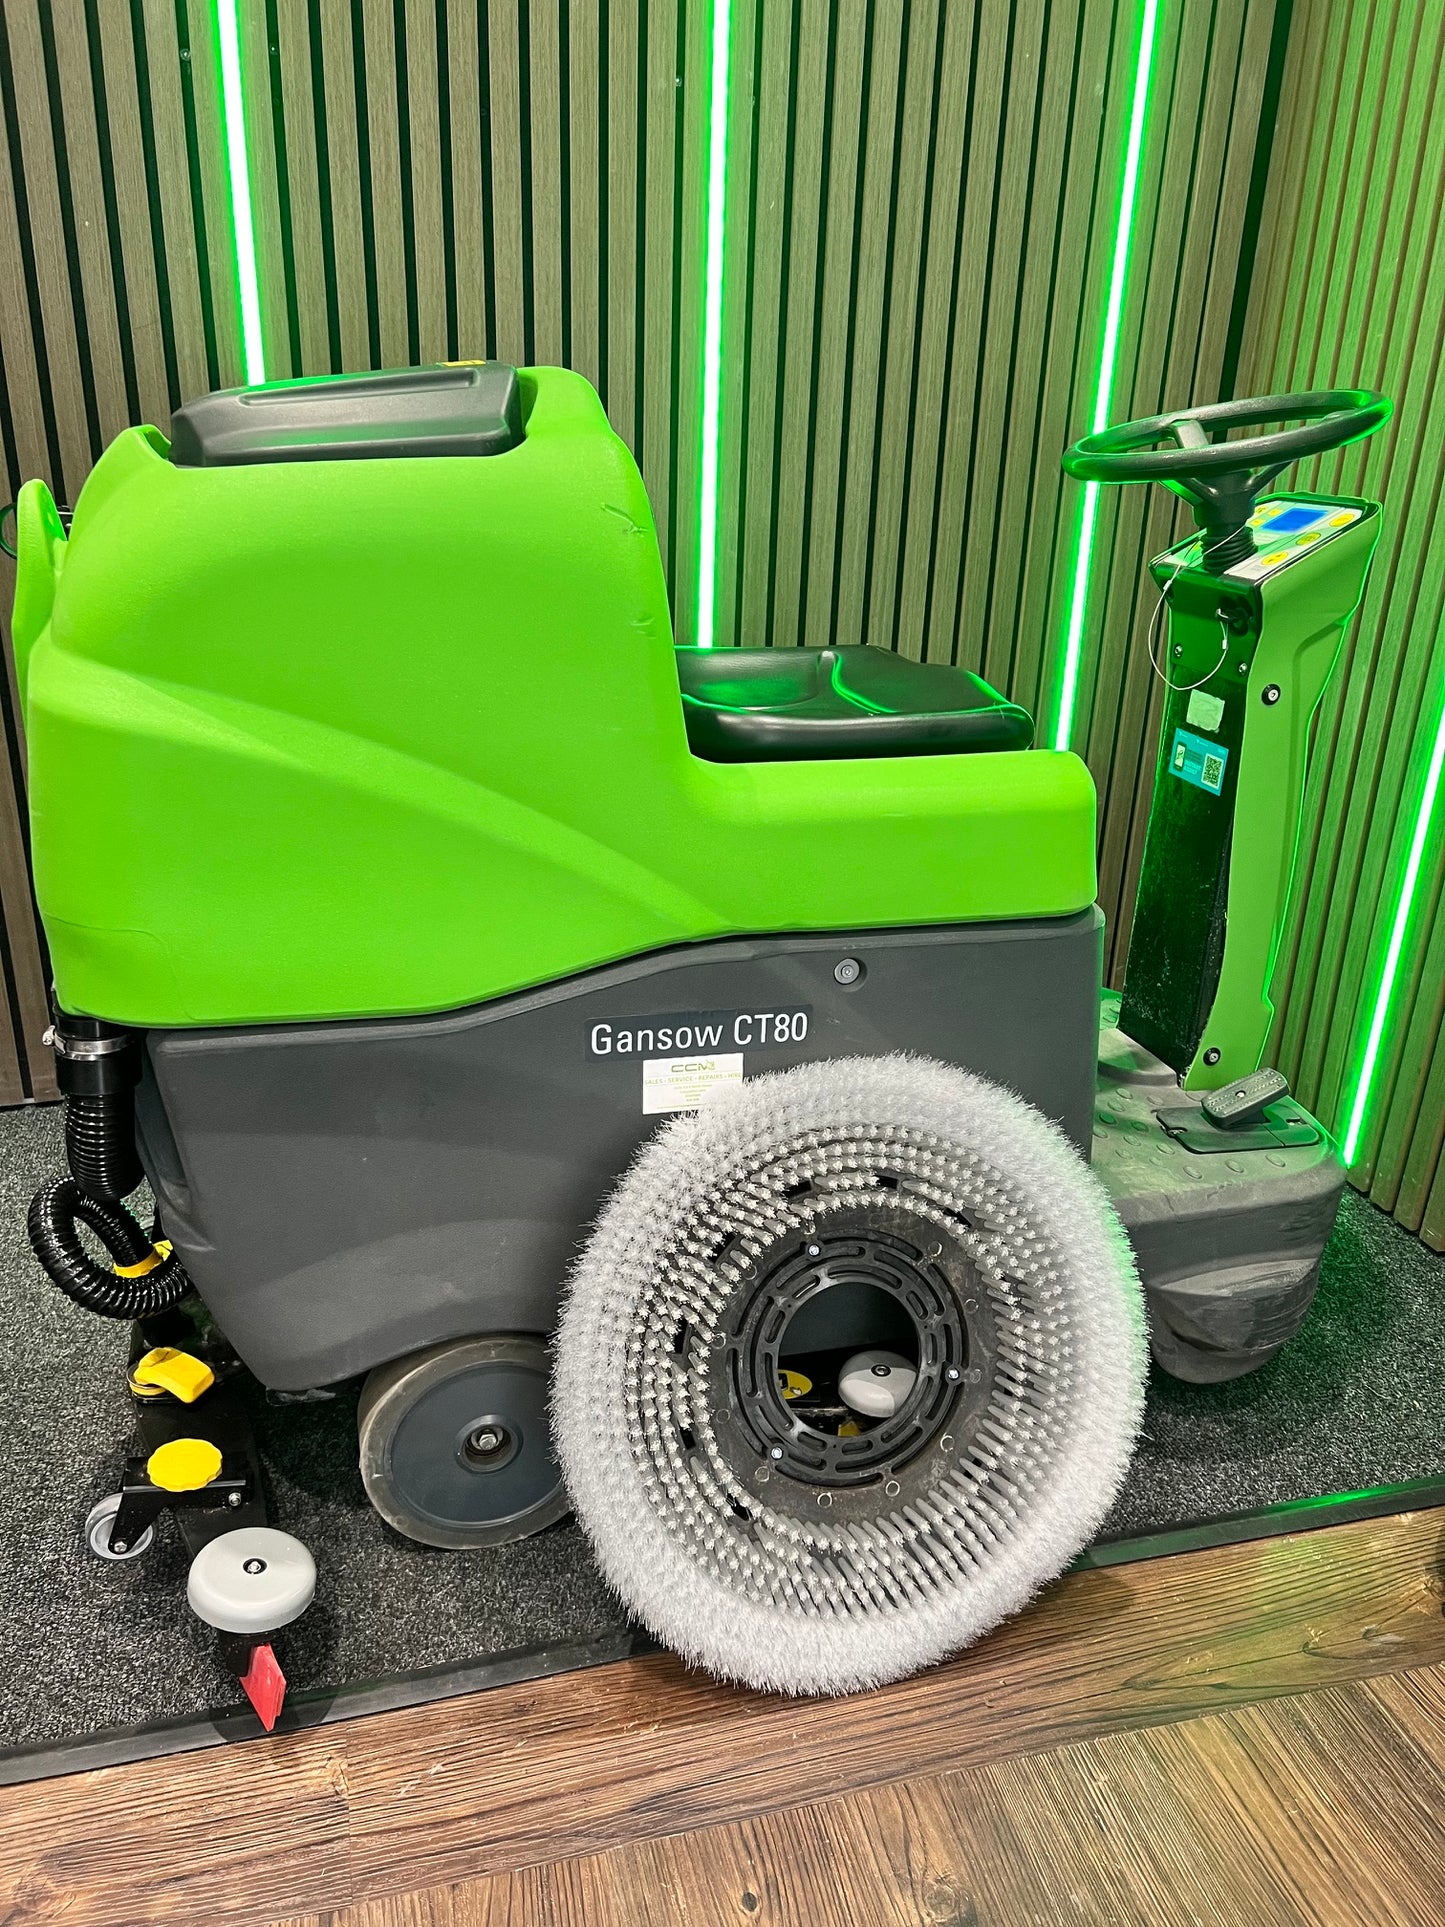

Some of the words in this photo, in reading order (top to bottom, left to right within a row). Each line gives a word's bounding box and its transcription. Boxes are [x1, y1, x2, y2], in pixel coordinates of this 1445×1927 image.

[591, 1023, 724, 1055] Gansow
[733, 1012, 808, 1045] CT80
[668, 1076, 693, 1084] SERVICE
[698, 1073, 723, 1081] REPAIRS
